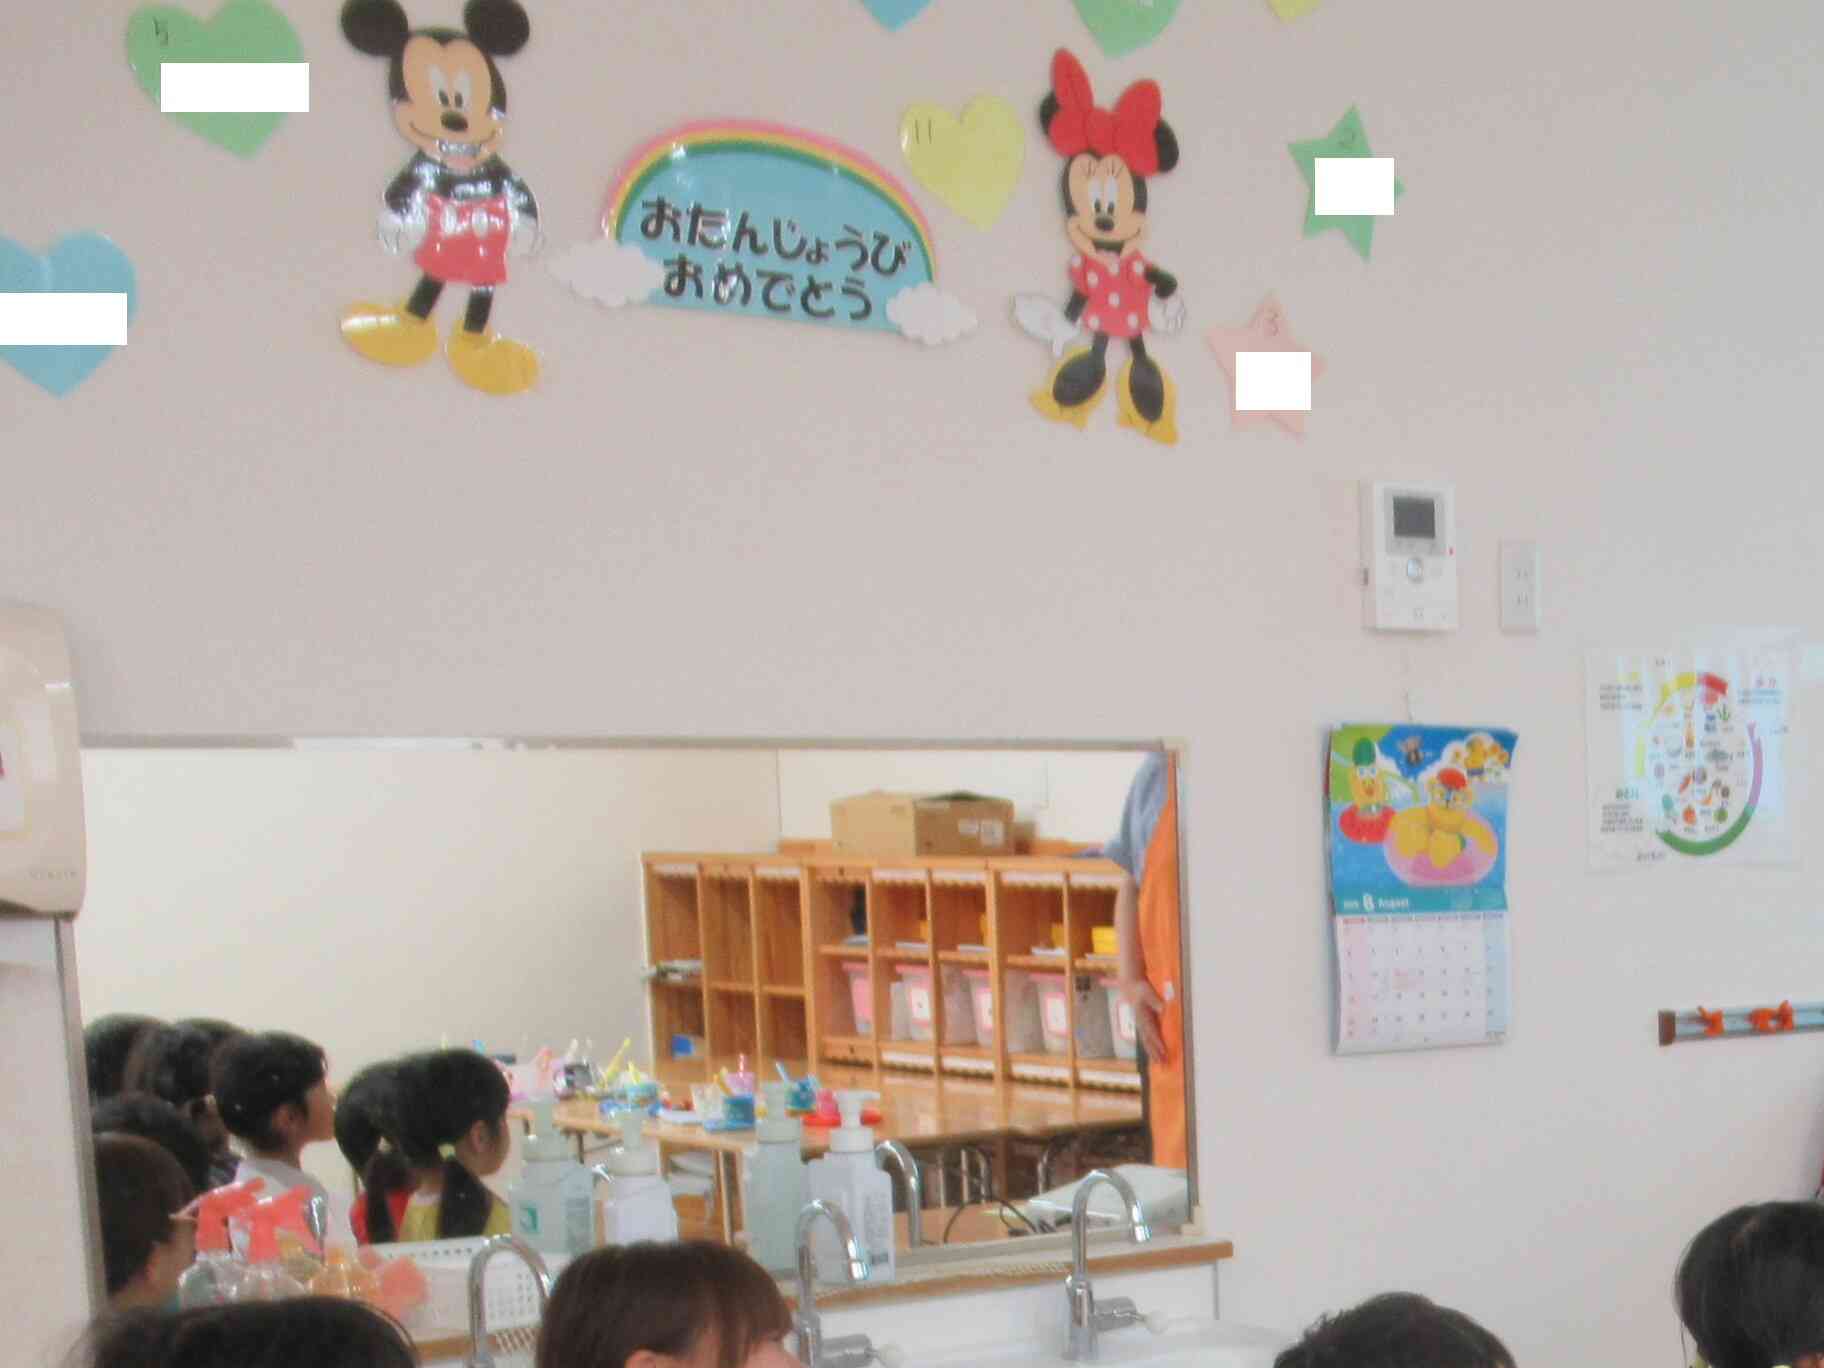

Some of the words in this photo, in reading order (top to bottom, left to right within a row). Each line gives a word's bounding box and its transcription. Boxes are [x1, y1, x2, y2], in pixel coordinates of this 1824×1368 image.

[641, 196, 911, 276] おたんじょうび
[663, 253, 872, 320] おめでとう
